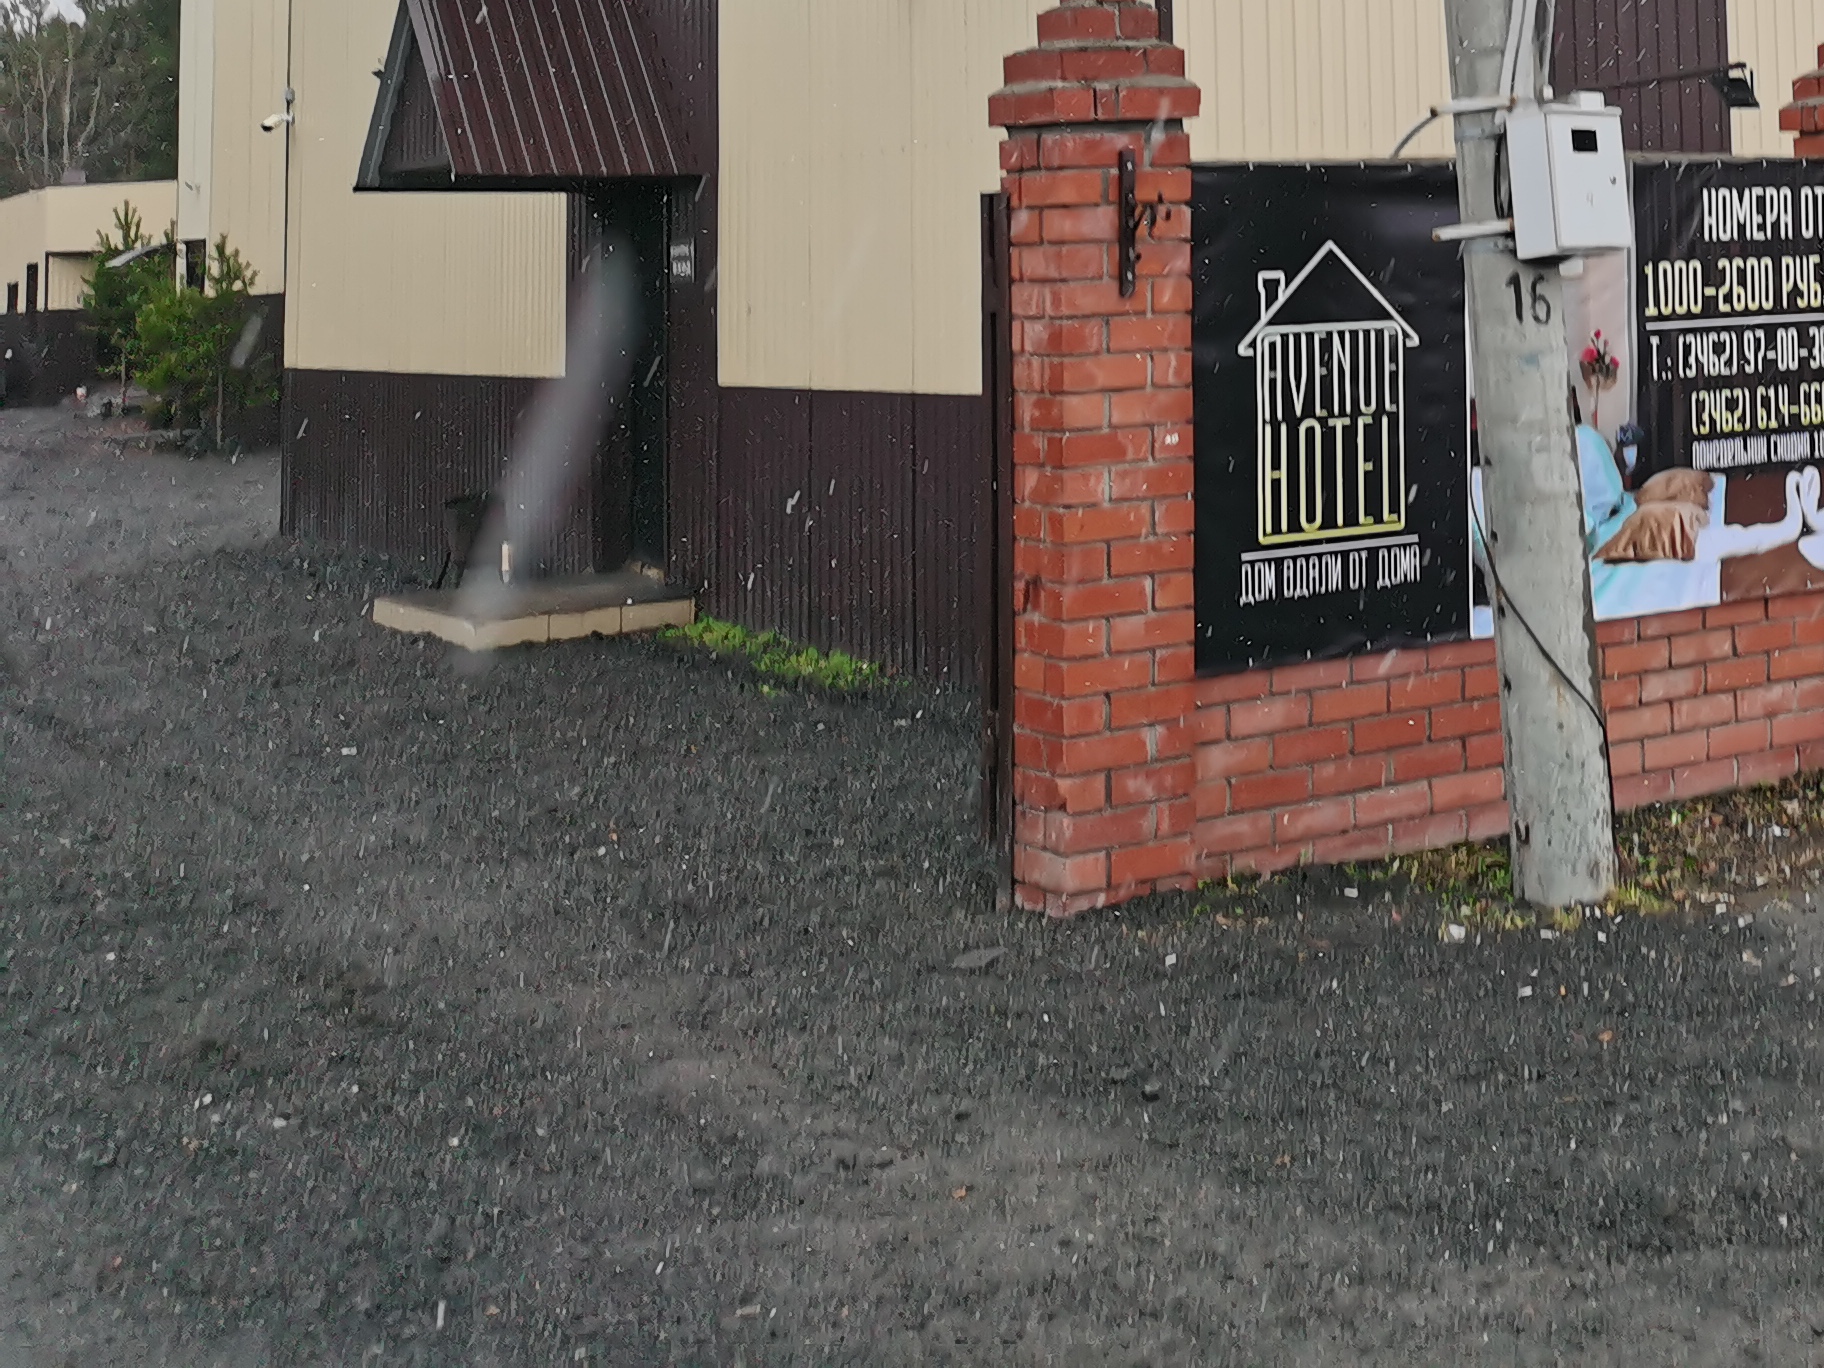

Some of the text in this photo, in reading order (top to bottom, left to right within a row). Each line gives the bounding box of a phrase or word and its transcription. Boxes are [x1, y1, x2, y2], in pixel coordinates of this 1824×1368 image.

[1702, 185, 1793, 243] НОМЕРА
[1505, 272, 1551, 325] 16
[1644, 255, 1774, 317] 1000-2600
[1263, 327, 1397, 423] AVENUE
[1678, 329, 1738, 379] (3462)
[1691, 386, 1750, 436] (3462)
[1264, 414, 1399, 534] HOTEL
[1239, 544, 1421, 608] ДОМ ВДАЛИ ОТ ДОМА
